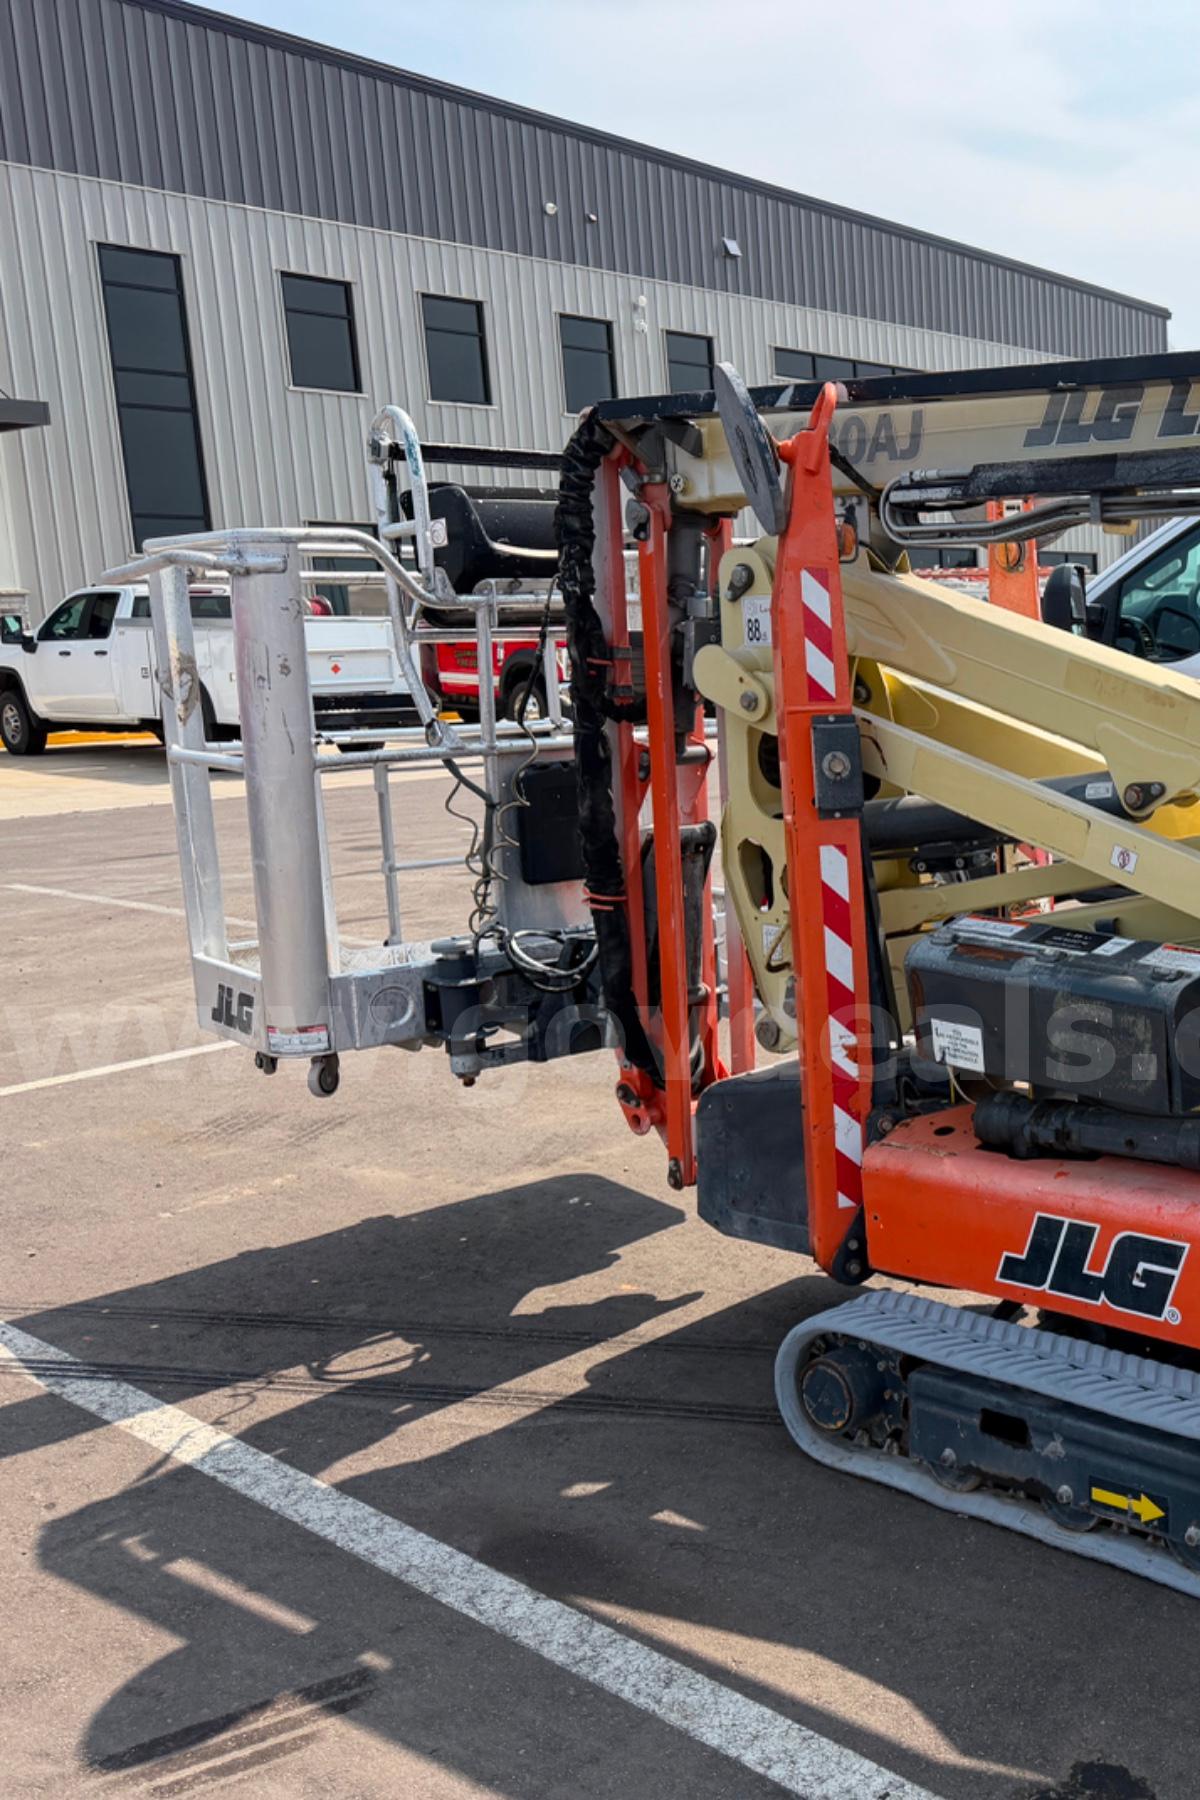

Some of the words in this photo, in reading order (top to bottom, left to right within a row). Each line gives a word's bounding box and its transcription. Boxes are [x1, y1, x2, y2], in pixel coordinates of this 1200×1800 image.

[1023, 386, 1145, 448] JLG
[747, 618, 761, 641] 88
[211, 983, 255, 1035] JLG
[996, 1212, 1190, 1322] JLG
